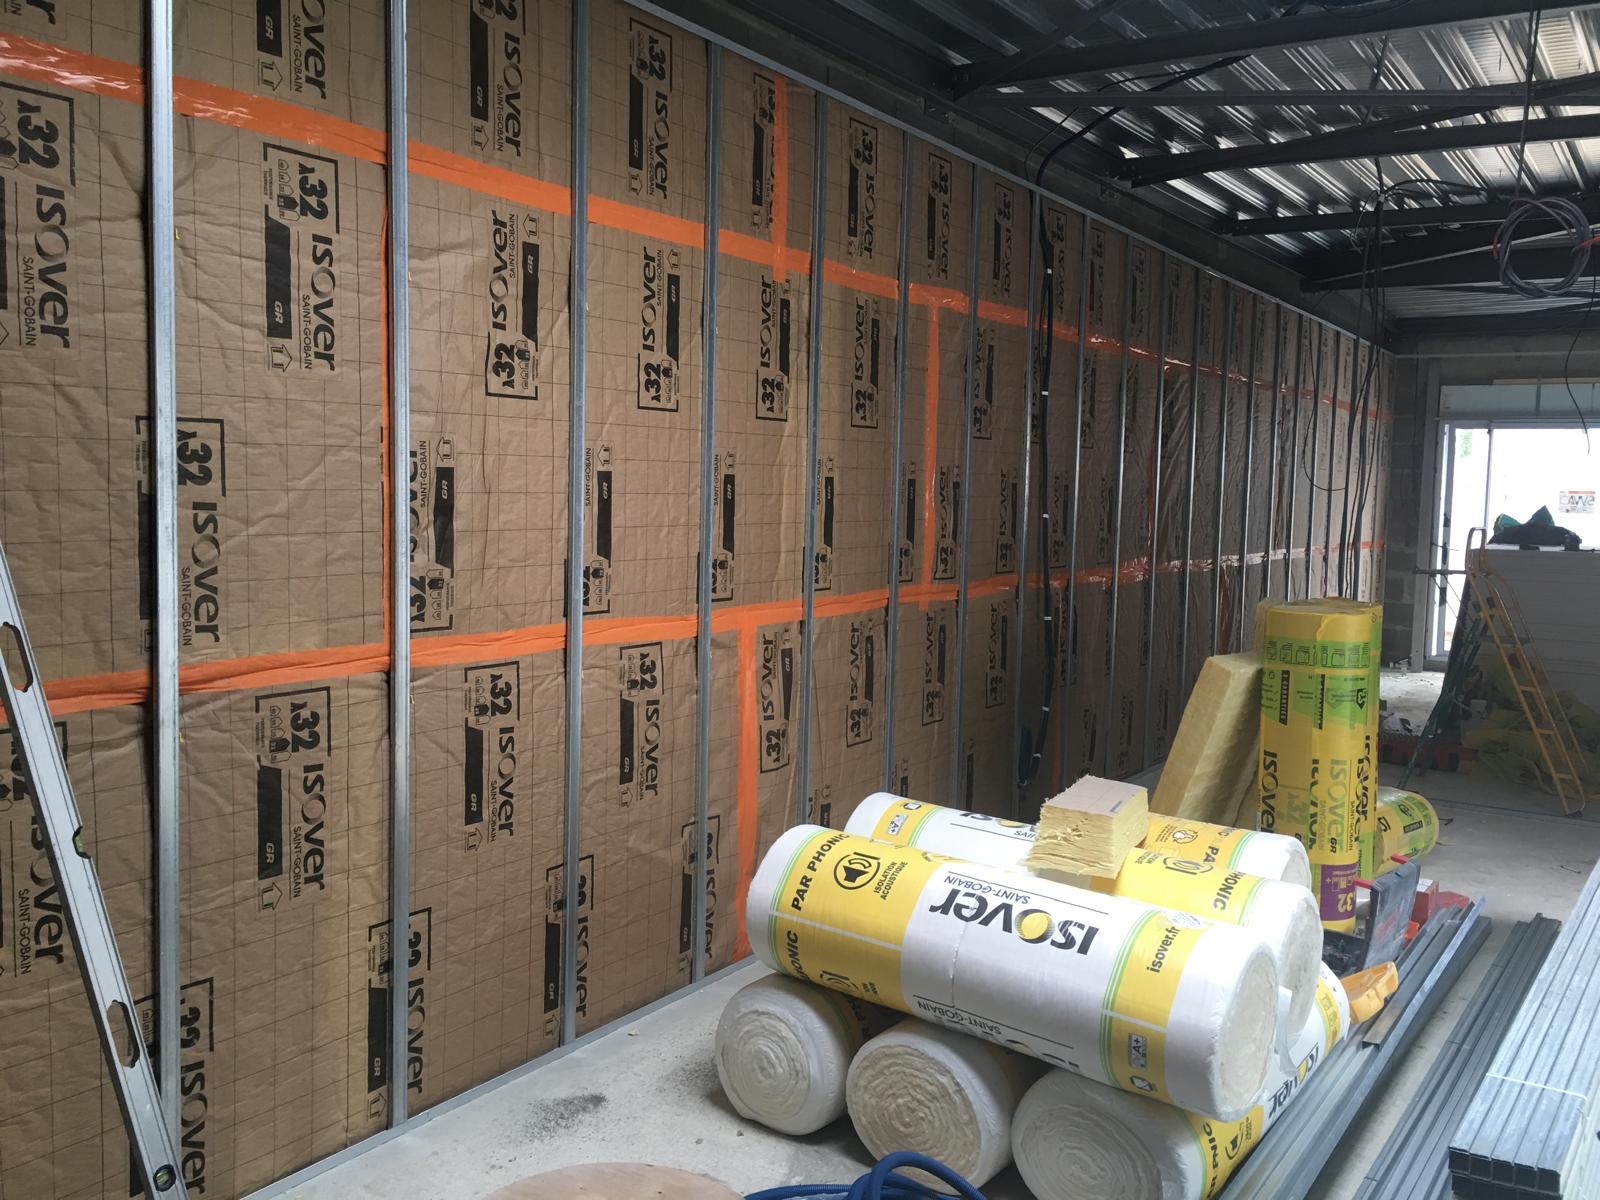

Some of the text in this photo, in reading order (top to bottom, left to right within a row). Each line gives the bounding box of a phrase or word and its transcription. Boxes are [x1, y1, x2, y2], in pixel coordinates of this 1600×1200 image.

[264, 16, 274, 40] GR
[291, 14, 303, 93] SAINT-GOBAIN
[474, 86, 483, 107] GR
[508, 213, 516, 279] SAINT-GOBAIN
[527, 255, 534, 275] GR
[23, 256, 37, 346] SAINT-GOBAIN
[274, 300, 284, 325] GR
[302, 294, 313, 370] SAINT-GOBAIN
[419, 440, 428, 508] SAINT-GOBAIN
[441, 480, 449, 500] GR
[584, 447, 592, 507] SAINT-GOBAIN
[602, 481, 609, 499] GR
[181, 566, 192, 646] SAINT-GOBAIN
[624, 756, 631, 774] GR
[470, 792, 478, 812] GR
[490, 779, 498, 843] SAINT-GOBAIN
[265, 842, 275, 865] GR
[1330, 837, 1337, 853] GR
[292, 826, 303, 898] SAINT-GOBAIN
[791, 833, 850, 911] PAR PHONIC
[874, 861, 898, 894] ISOLATION
[880, 861, 909, 901] ACOUSTIQUE
[943, 874, 1032, 905] SAINT-GOBAIN
[18, 889, 32, 975] SAINT-GOBAIN
[1146, 926, 1182, 974] isover.fr
[1133, 1037, 1142, 1056] A+
[374, 1057, 380, 1077] GR
